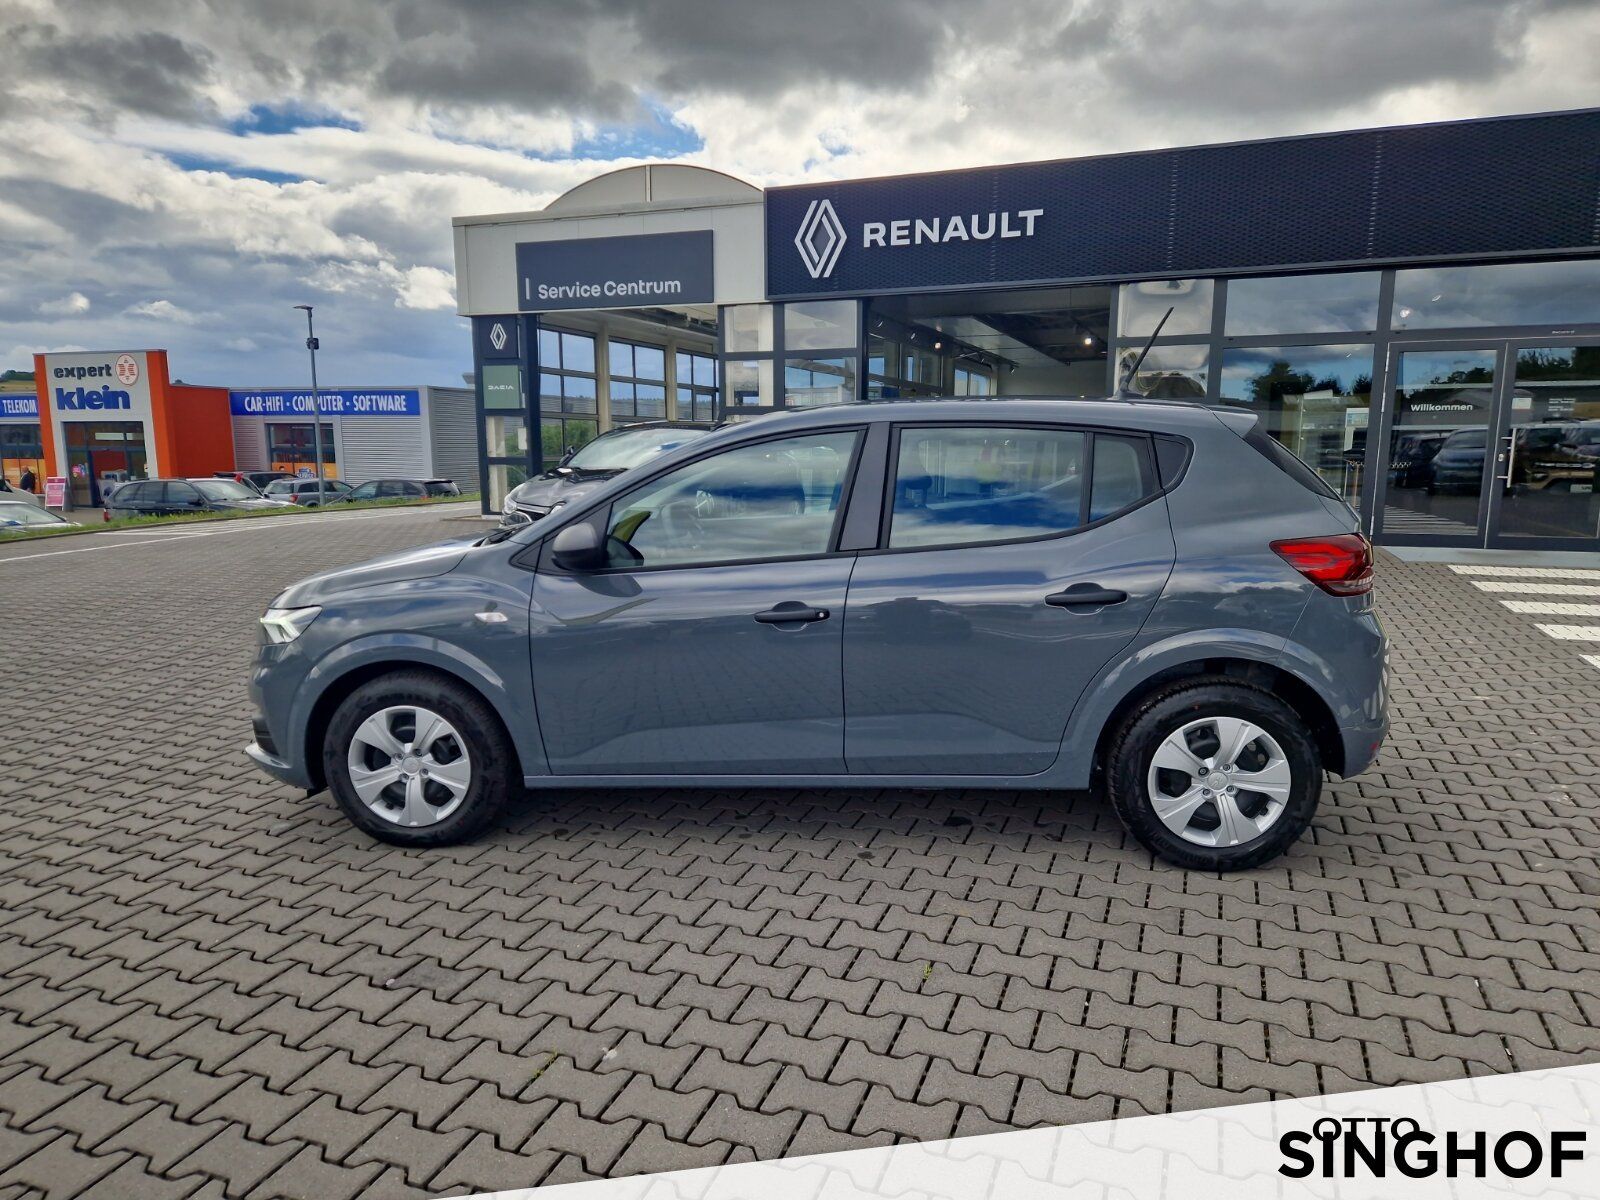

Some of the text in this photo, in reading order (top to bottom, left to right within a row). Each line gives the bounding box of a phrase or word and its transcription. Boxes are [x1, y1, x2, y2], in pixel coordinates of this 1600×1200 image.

[863, 208, 1044, 248] RENAULT
[538, 279, 681, 300] Service Centrum
[54, 364, 113, 380] expert
[3, 399, 38, 413] TELEKOM
[55, 385, 131, 410] klein
[244, 395, 284, 412] CAR-HIFI
[353, 394, 407, 411] SOFTWARE
[1411, 403, 1473, 412] Willkommen
